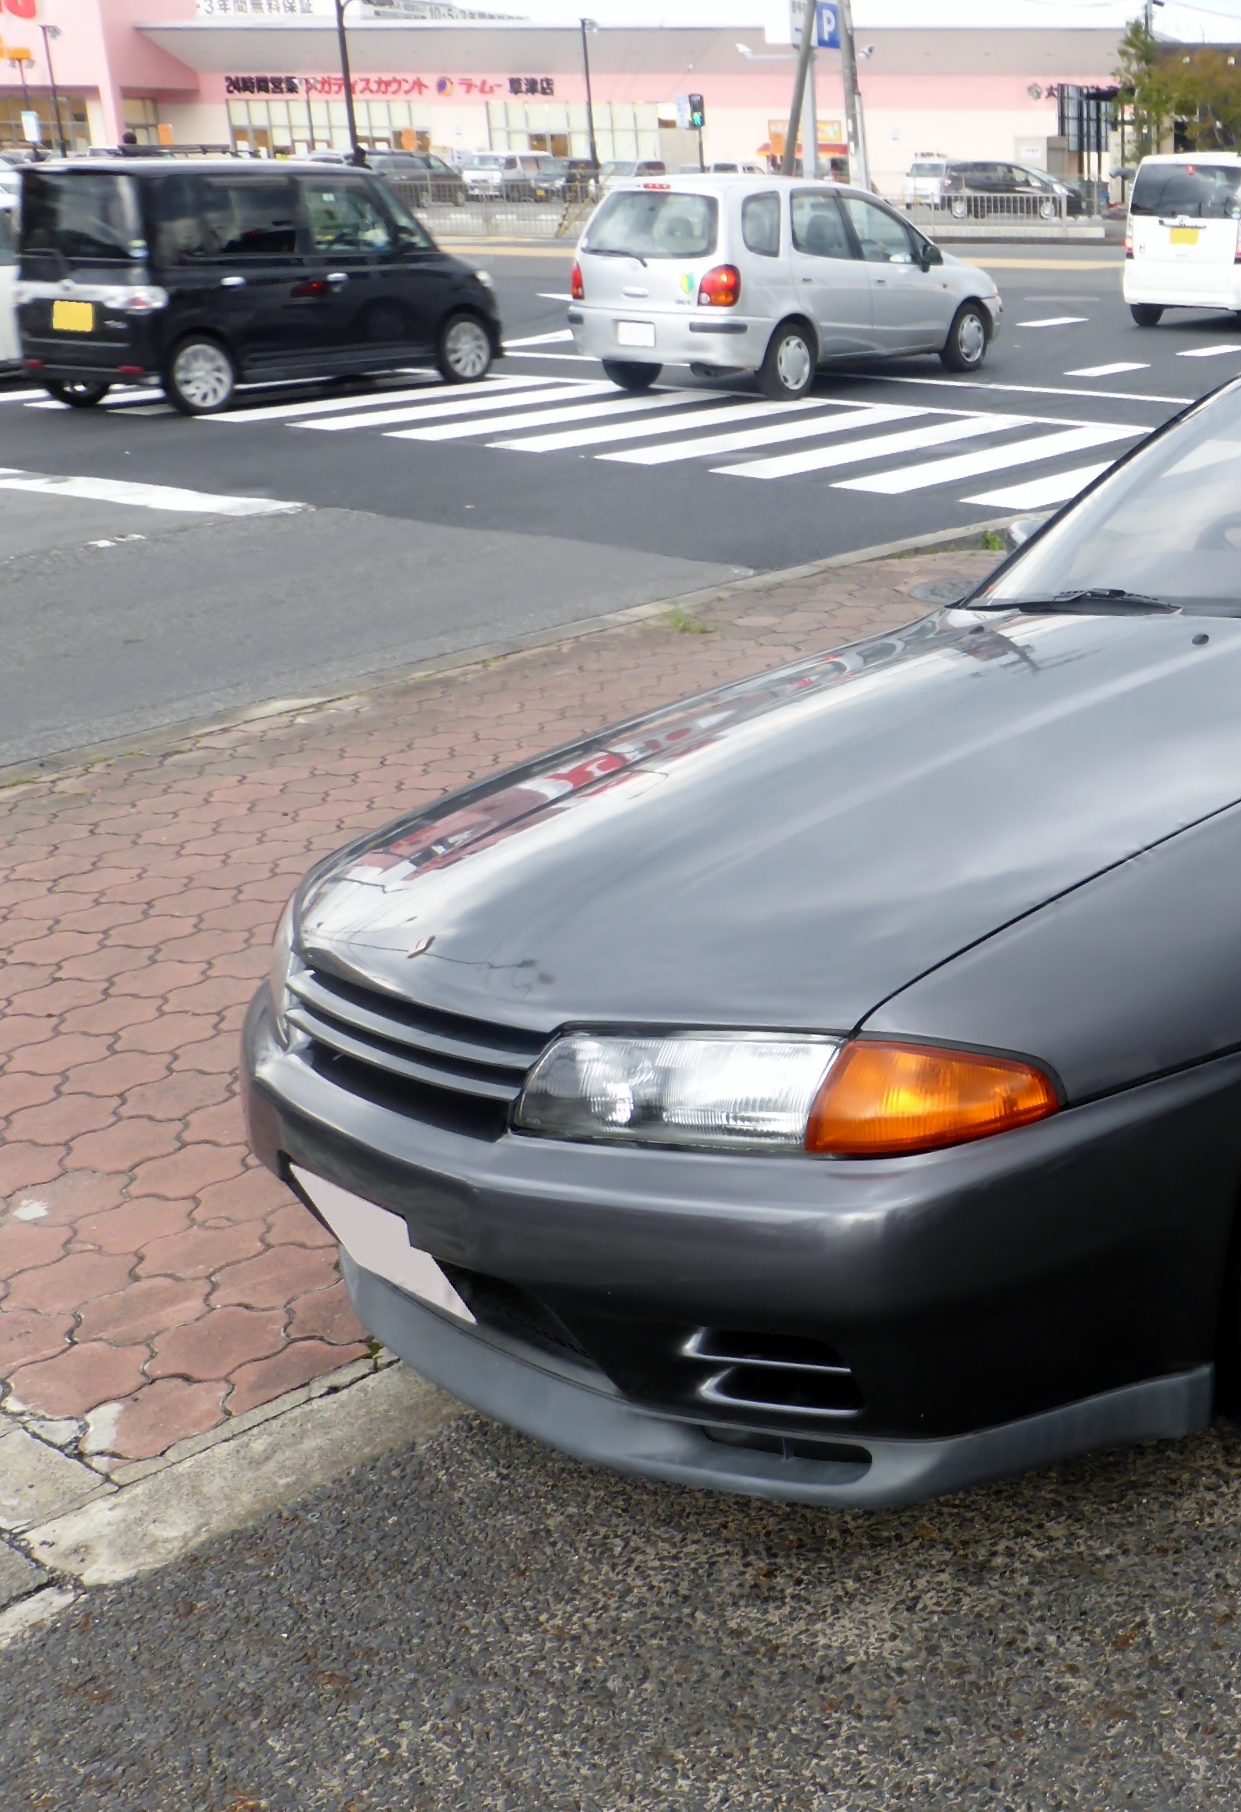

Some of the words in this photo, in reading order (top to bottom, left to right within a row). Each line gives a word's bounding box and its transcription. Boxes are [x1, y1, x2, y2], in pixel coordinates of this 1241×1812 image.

[822, 9, 835, 41] P
[508, 77, 554, 95] 草津店
